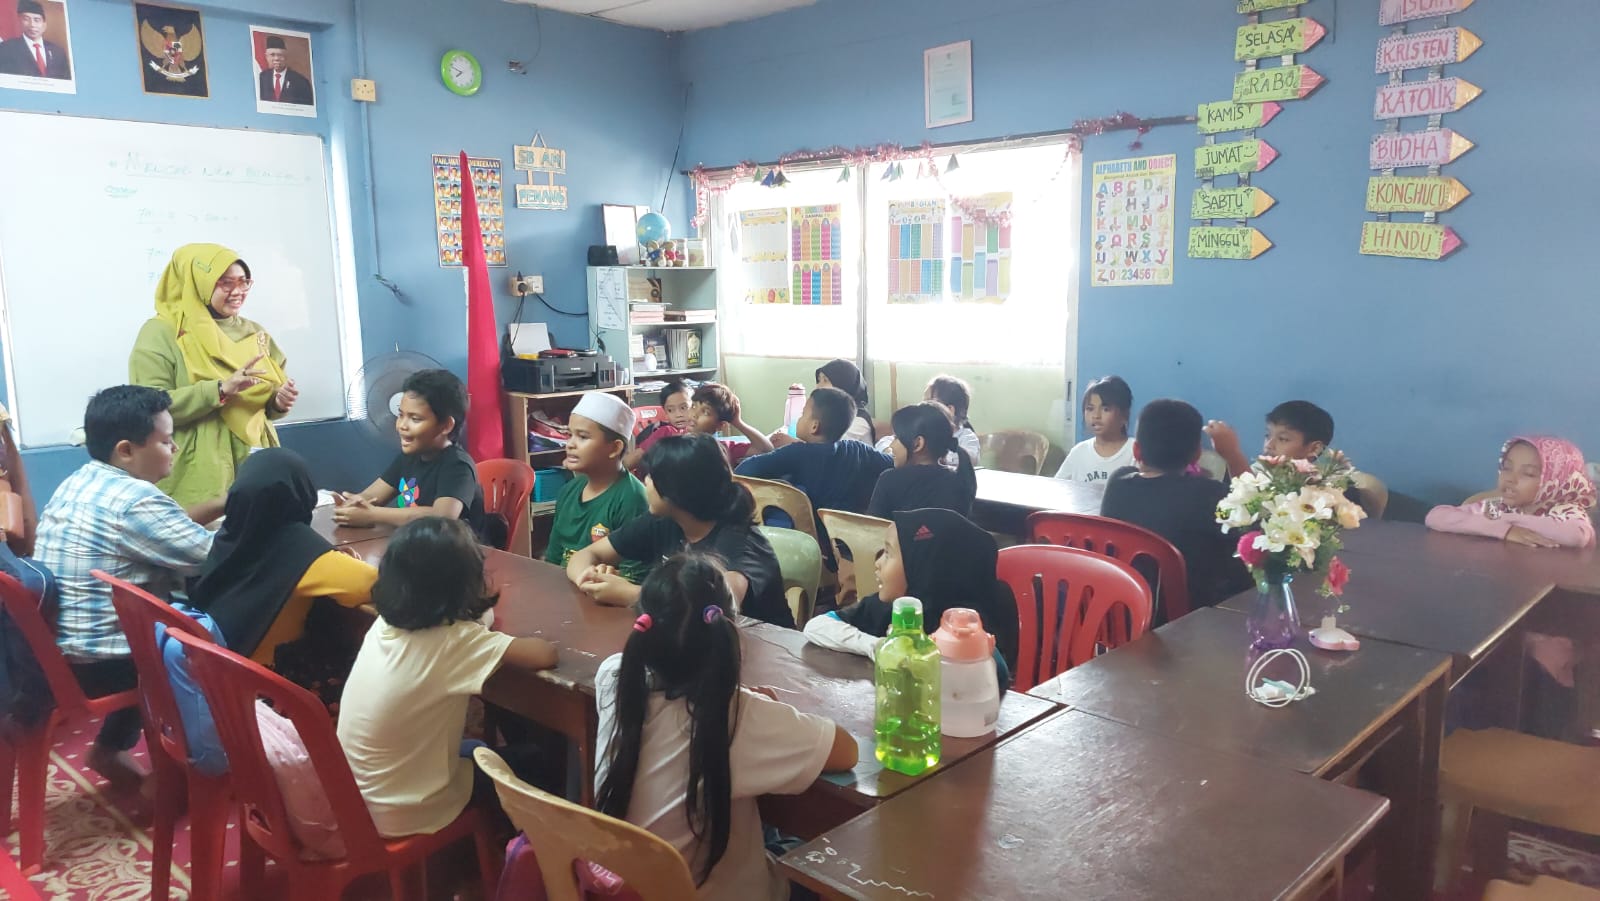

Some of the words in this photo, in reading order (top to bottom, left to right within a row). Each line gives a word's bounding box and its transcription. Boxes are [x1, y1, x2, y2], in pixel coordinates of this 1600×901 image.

[1245, 28, 1294, 48] SELASA
[1383, 38, 1449, 64] KRISTEN
[1207, 102, 1244, 124] KAMIS
[1203, 145, 1243, 166] JUMAT
[1376, 136, 1439, 161] BUDHA
[1133, 159, 1147, 171] AND
[1202, 193, 1243, 210] SABTU
[1375, 182, 1446, 207] KONGHUCU
[1197, 230, 1240, 248] MINGGU
[1373, 227, 1432, 252] HINDU
